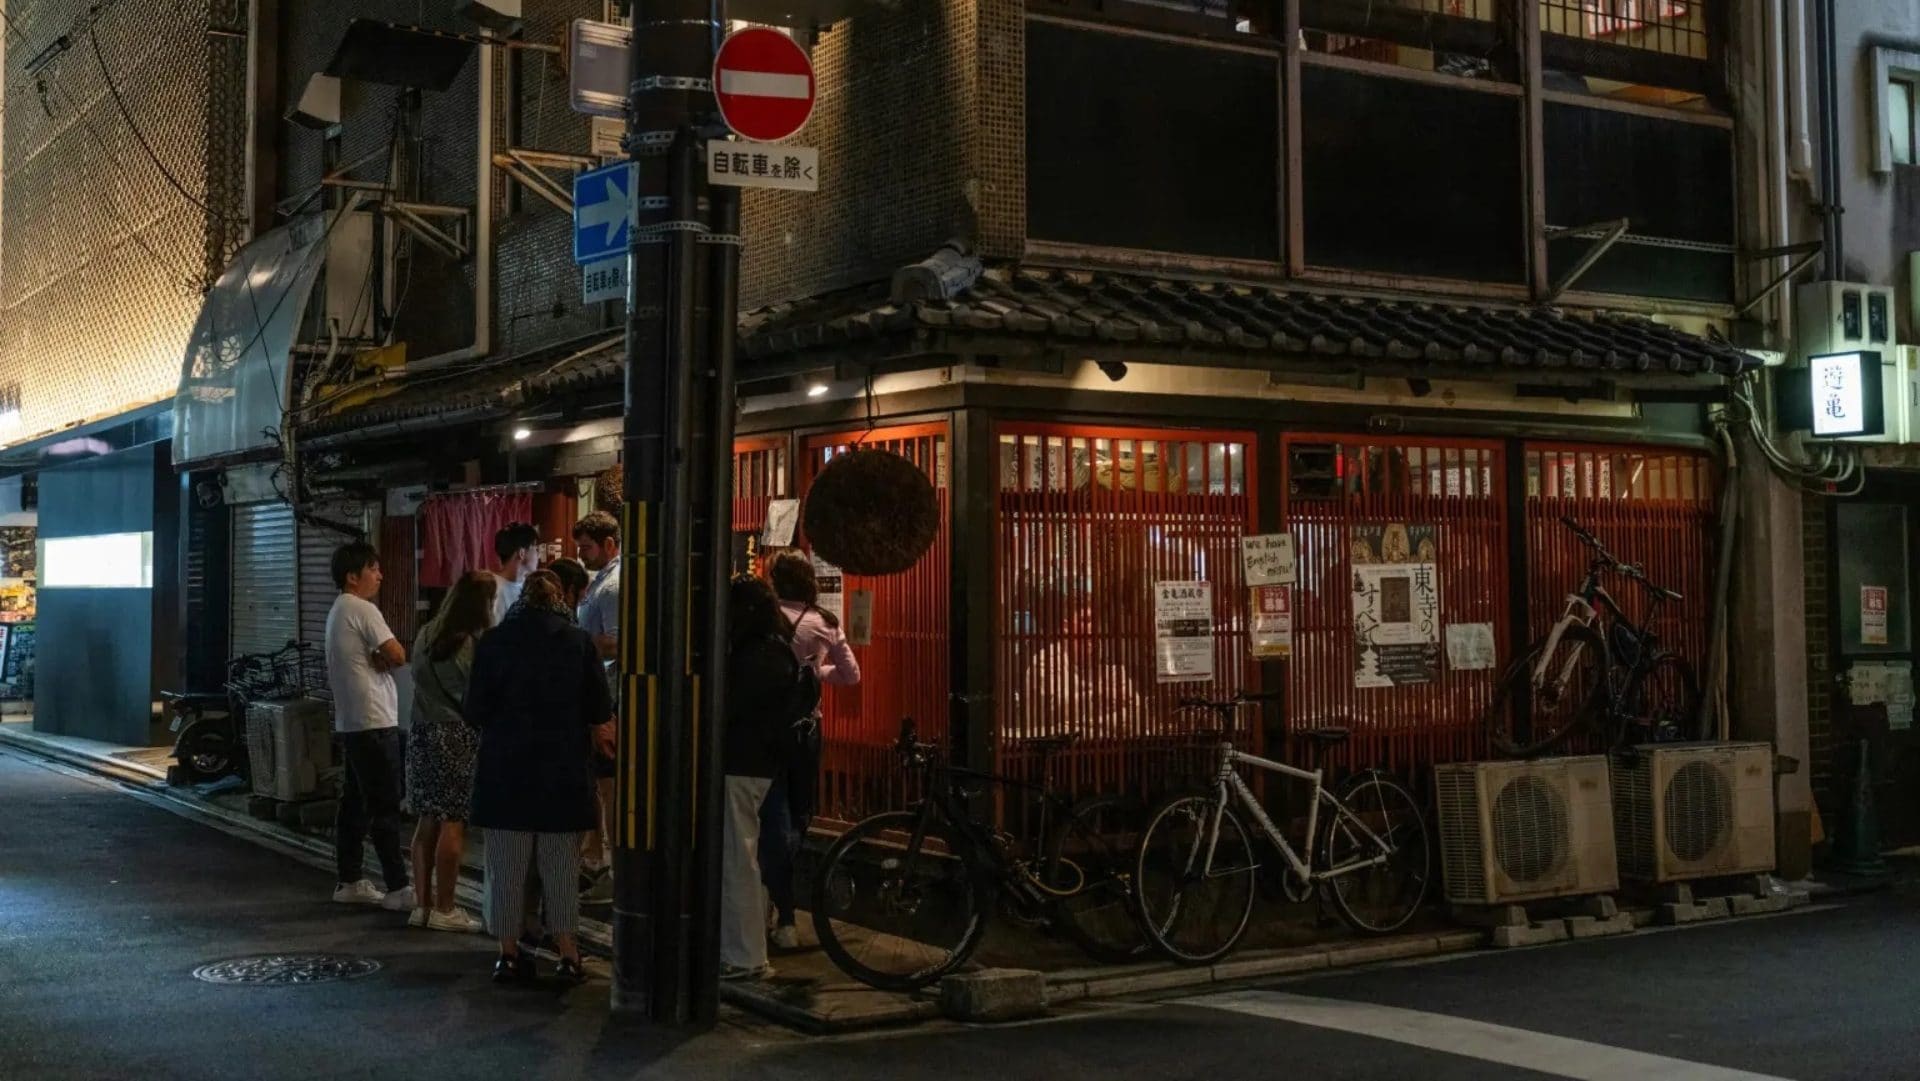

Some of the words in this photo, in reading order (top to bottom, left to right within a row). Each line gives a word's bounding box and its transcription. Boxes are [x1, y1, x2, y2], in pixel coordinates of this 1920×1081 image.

[713, 150, 813, 181] 自転車を除く
[1246, 551, 1279, 569] English
[1358, 584, 1380, 647] すべて
[1412, 561, 1437, 635] 東寺の
